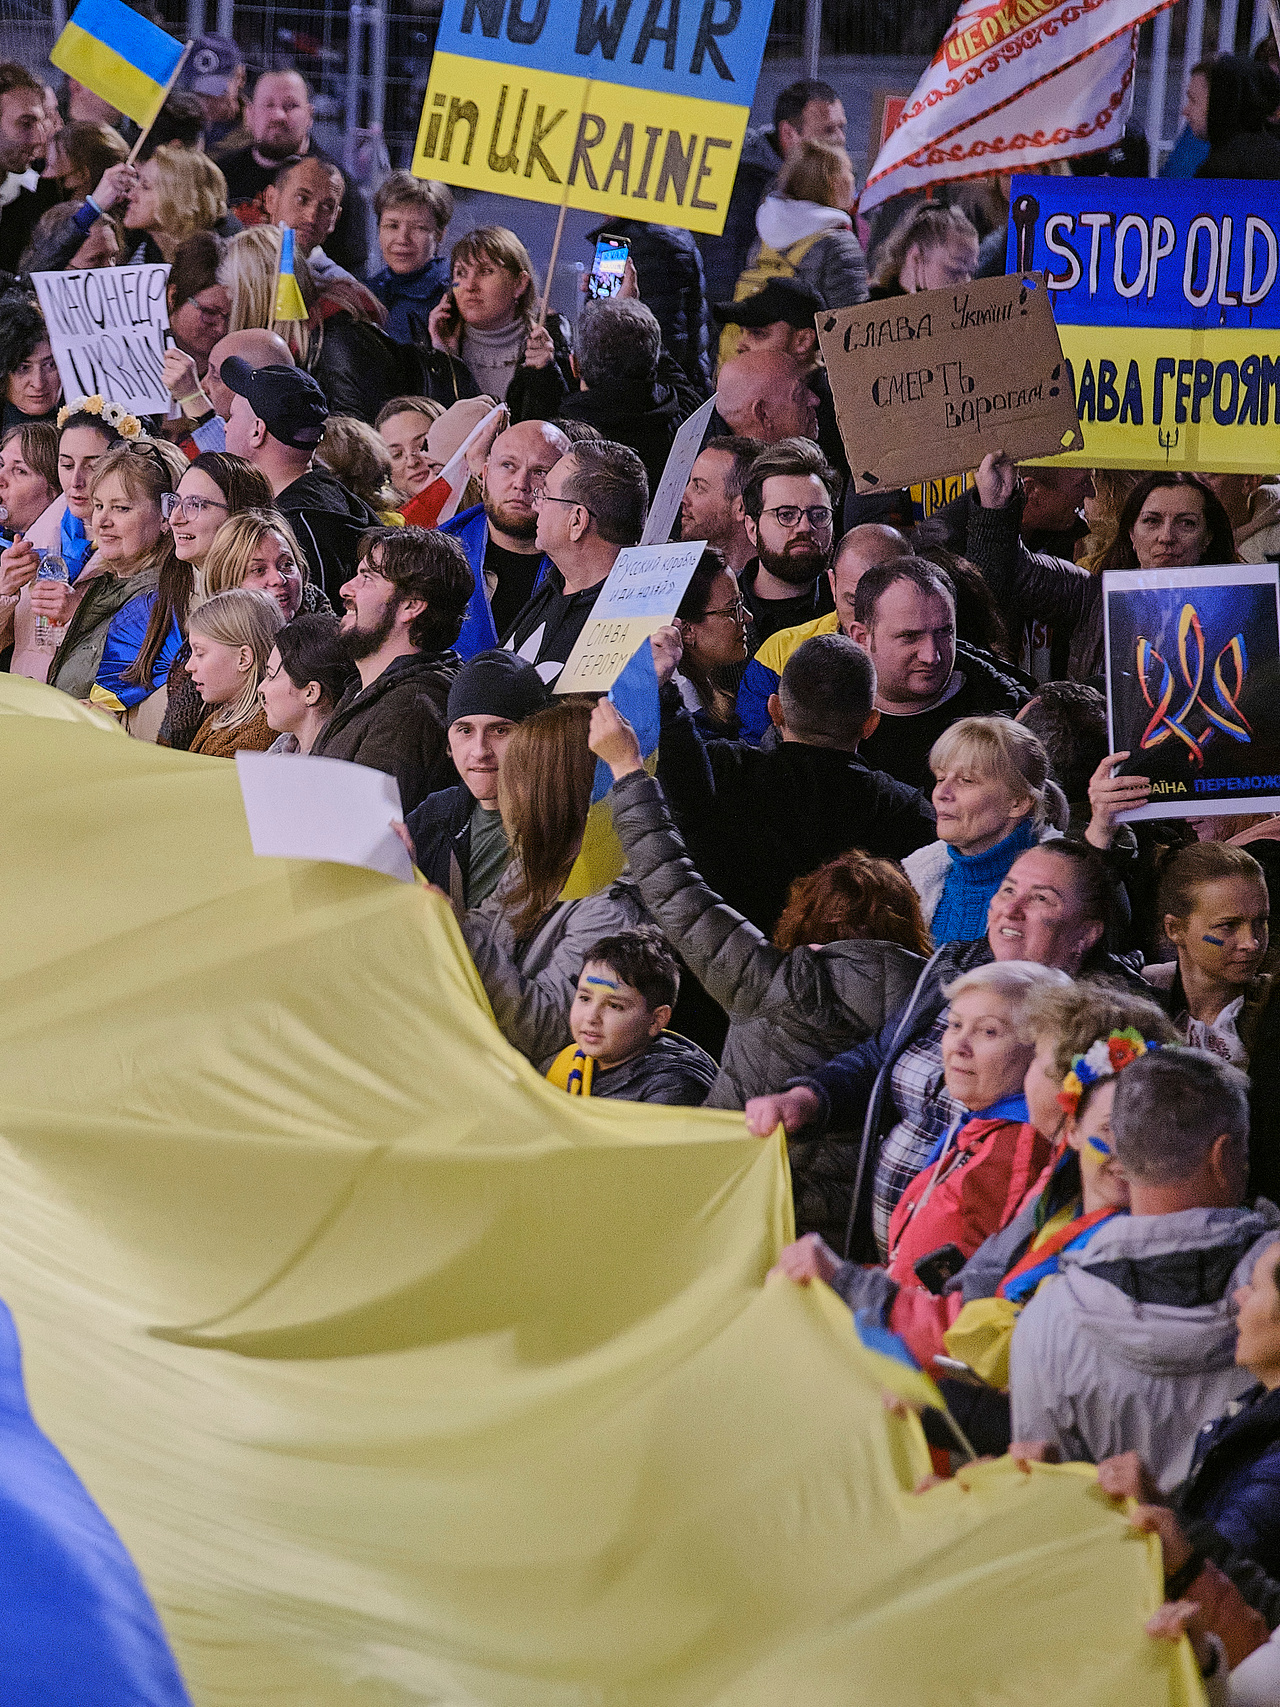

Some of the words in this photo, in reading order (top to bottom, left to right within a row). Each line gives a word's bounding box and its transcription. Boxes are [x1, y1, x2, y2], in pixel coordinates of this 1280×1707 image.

[575, 0, 742, 83] WAR
[423, 93, 480, 166] in
[488, 85, 733, 211] UKRAINE
[1044, 212, 1177, 298] STOP
[1182, 214, 1278, 307] OLD
[872, 361, 975, 407] СМЕРТЬ
[1065, 356, 1144, 426] АВА
[1152, 354, 1280, 426] ГЕРОЯМ
[573, 652, 635, 677] ГЕРОЯМ
[586, 623, 630, 647] СЛАВА
